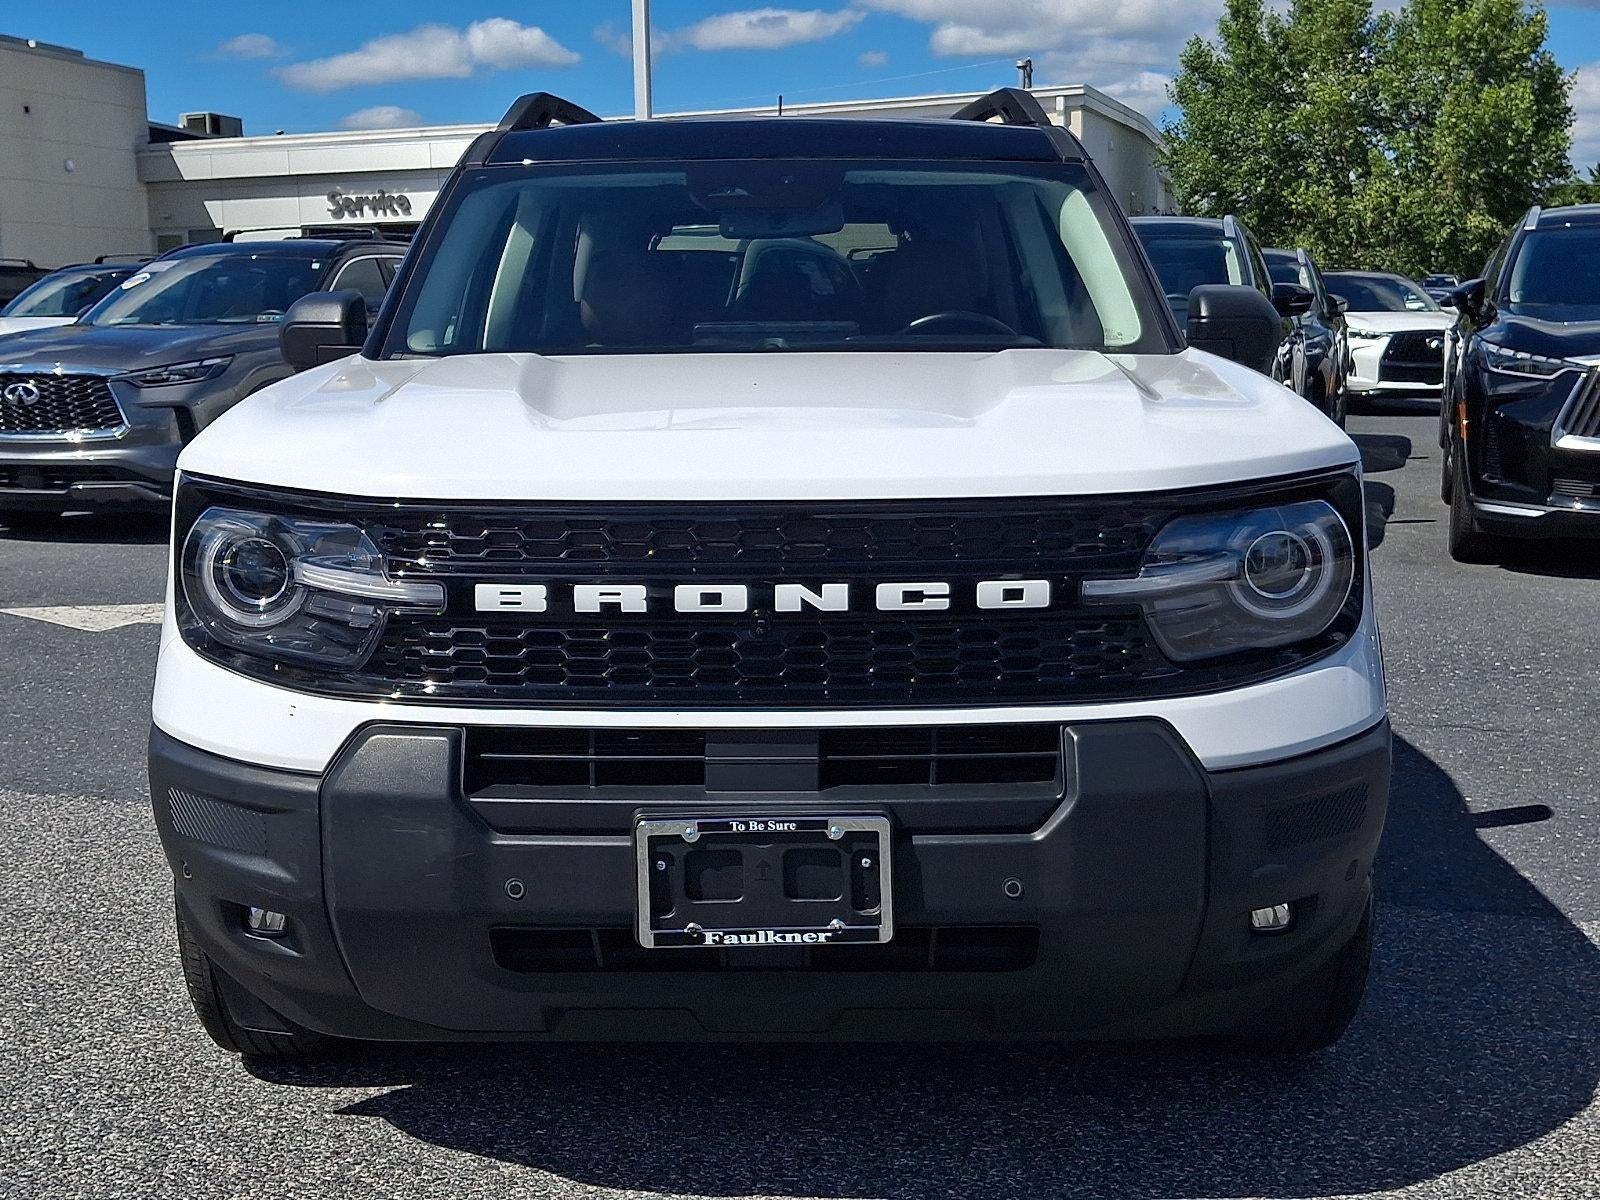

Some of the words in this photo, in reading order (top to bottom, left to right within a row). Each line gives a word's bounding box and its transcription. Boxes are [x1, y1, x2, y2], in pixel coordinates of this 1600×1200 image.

[327, 189, 412, 219] Service
[474, 580, 1050, 613] BRONCO
[729, 821, 746, 832] To
[748, 820, 765, 831] Be
[767, 820, 797, 831] Sure
[702, 930, 833, 945] Faulkner
